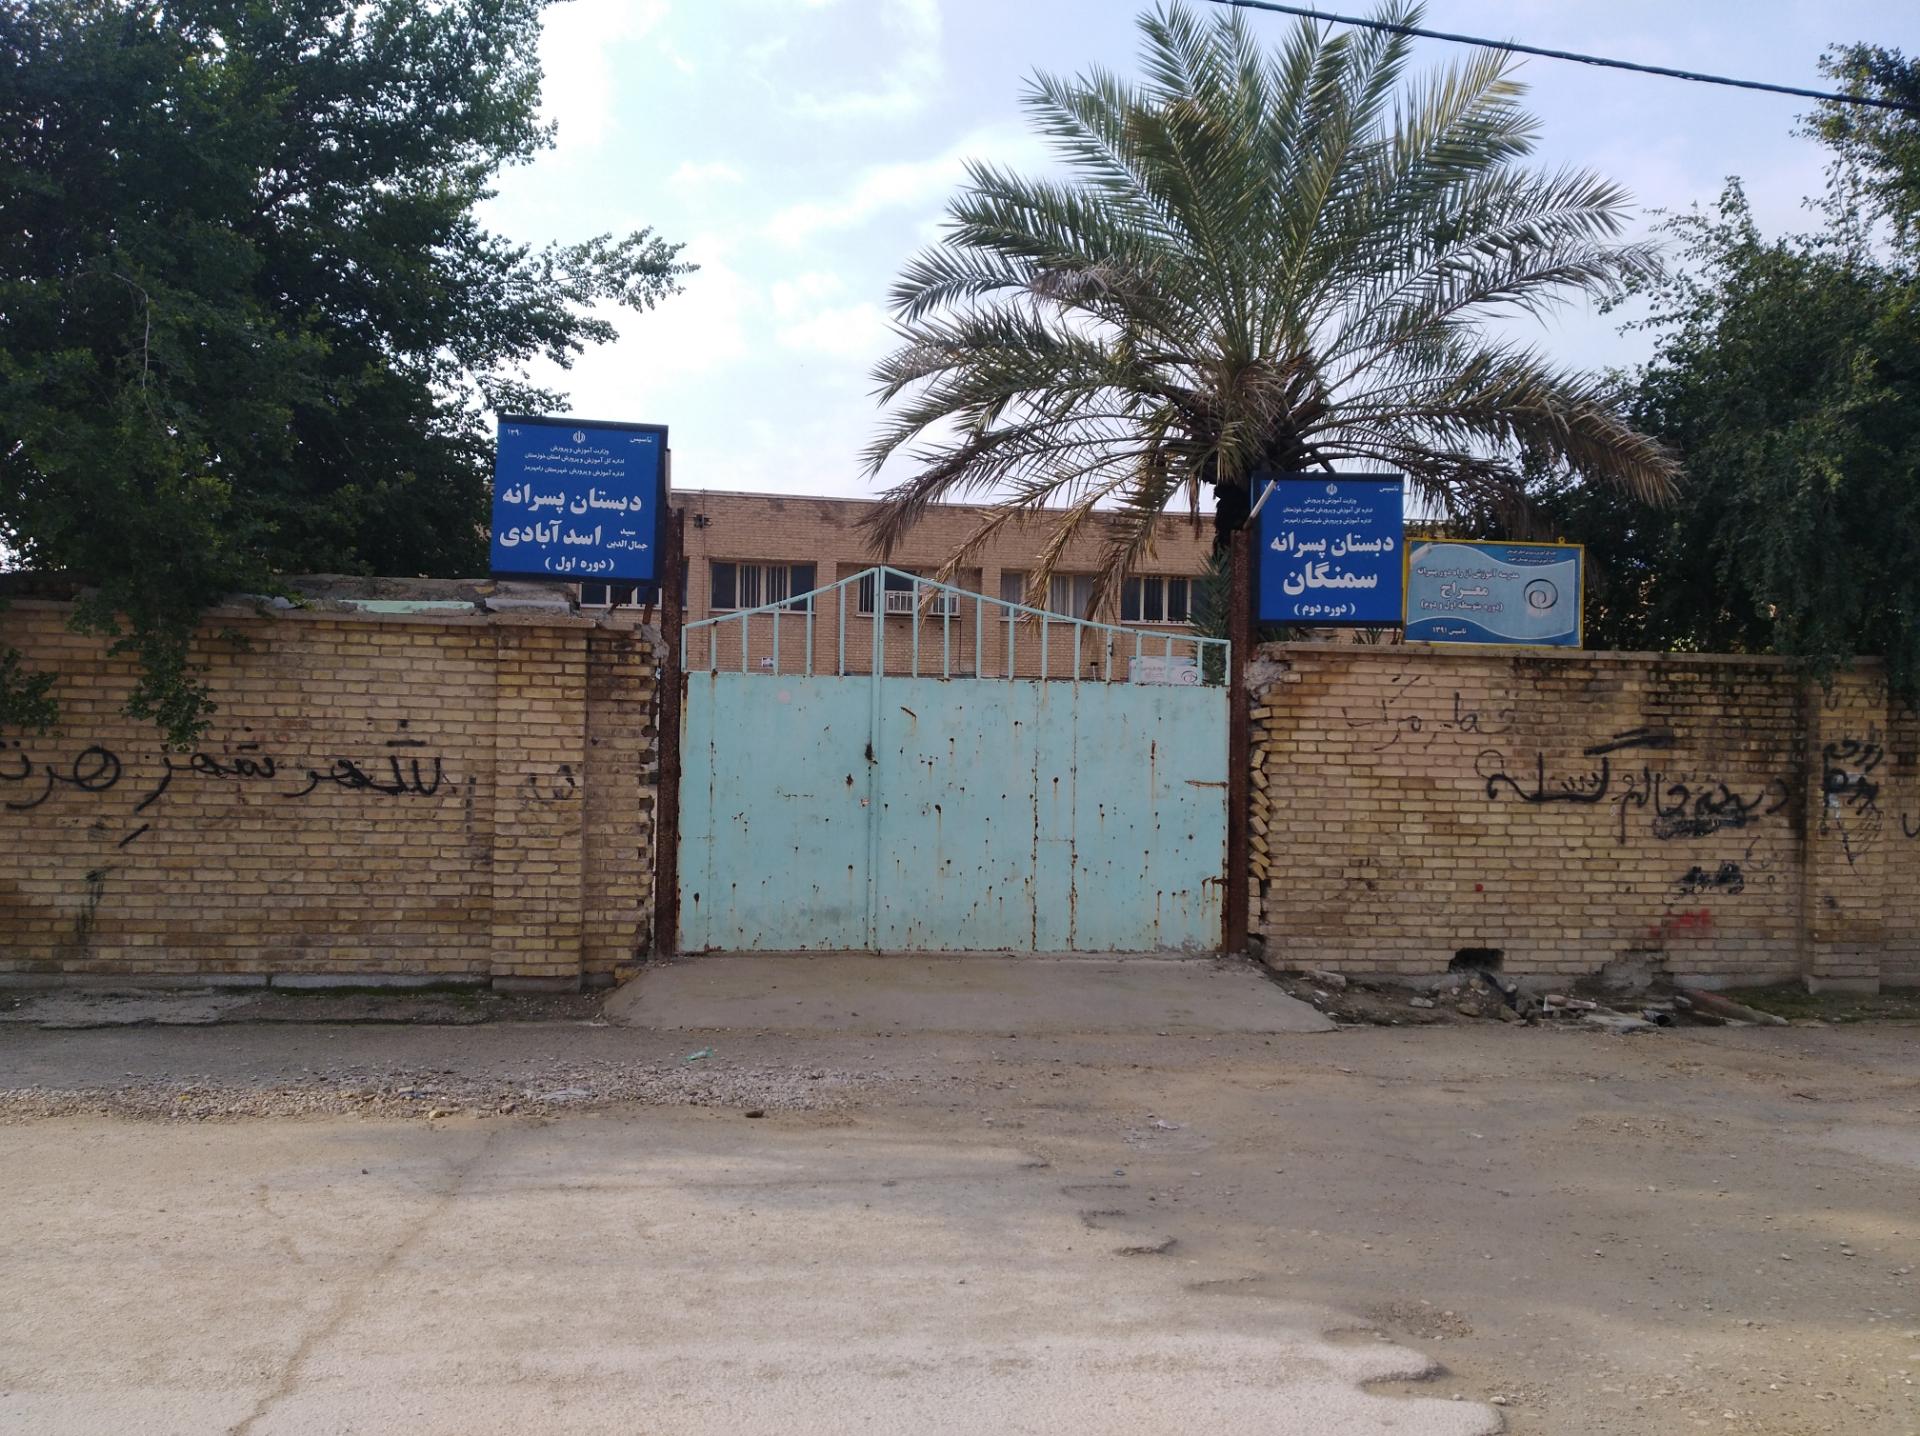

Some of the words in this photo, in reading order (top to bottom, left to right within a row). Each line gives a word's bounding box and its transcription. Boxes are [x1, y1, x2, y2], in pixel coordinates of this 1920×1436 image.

[502, 482, 566, 514] پسرانه
[570, 487, 642, 517] دبستان
[500, 520, 563, 549] آبادی
[563, 525, 602, 546] اسد
[620, 528, 636, 536] سید
[1270, 531, 1327, 558] پسرانه
[1331, 532, 1395, 557] دبستان
[628, 541, 648, 552] جمال
[1283, 561, 1378, 595] سمنگان
[1441, 582, 1489, 599] معراج
